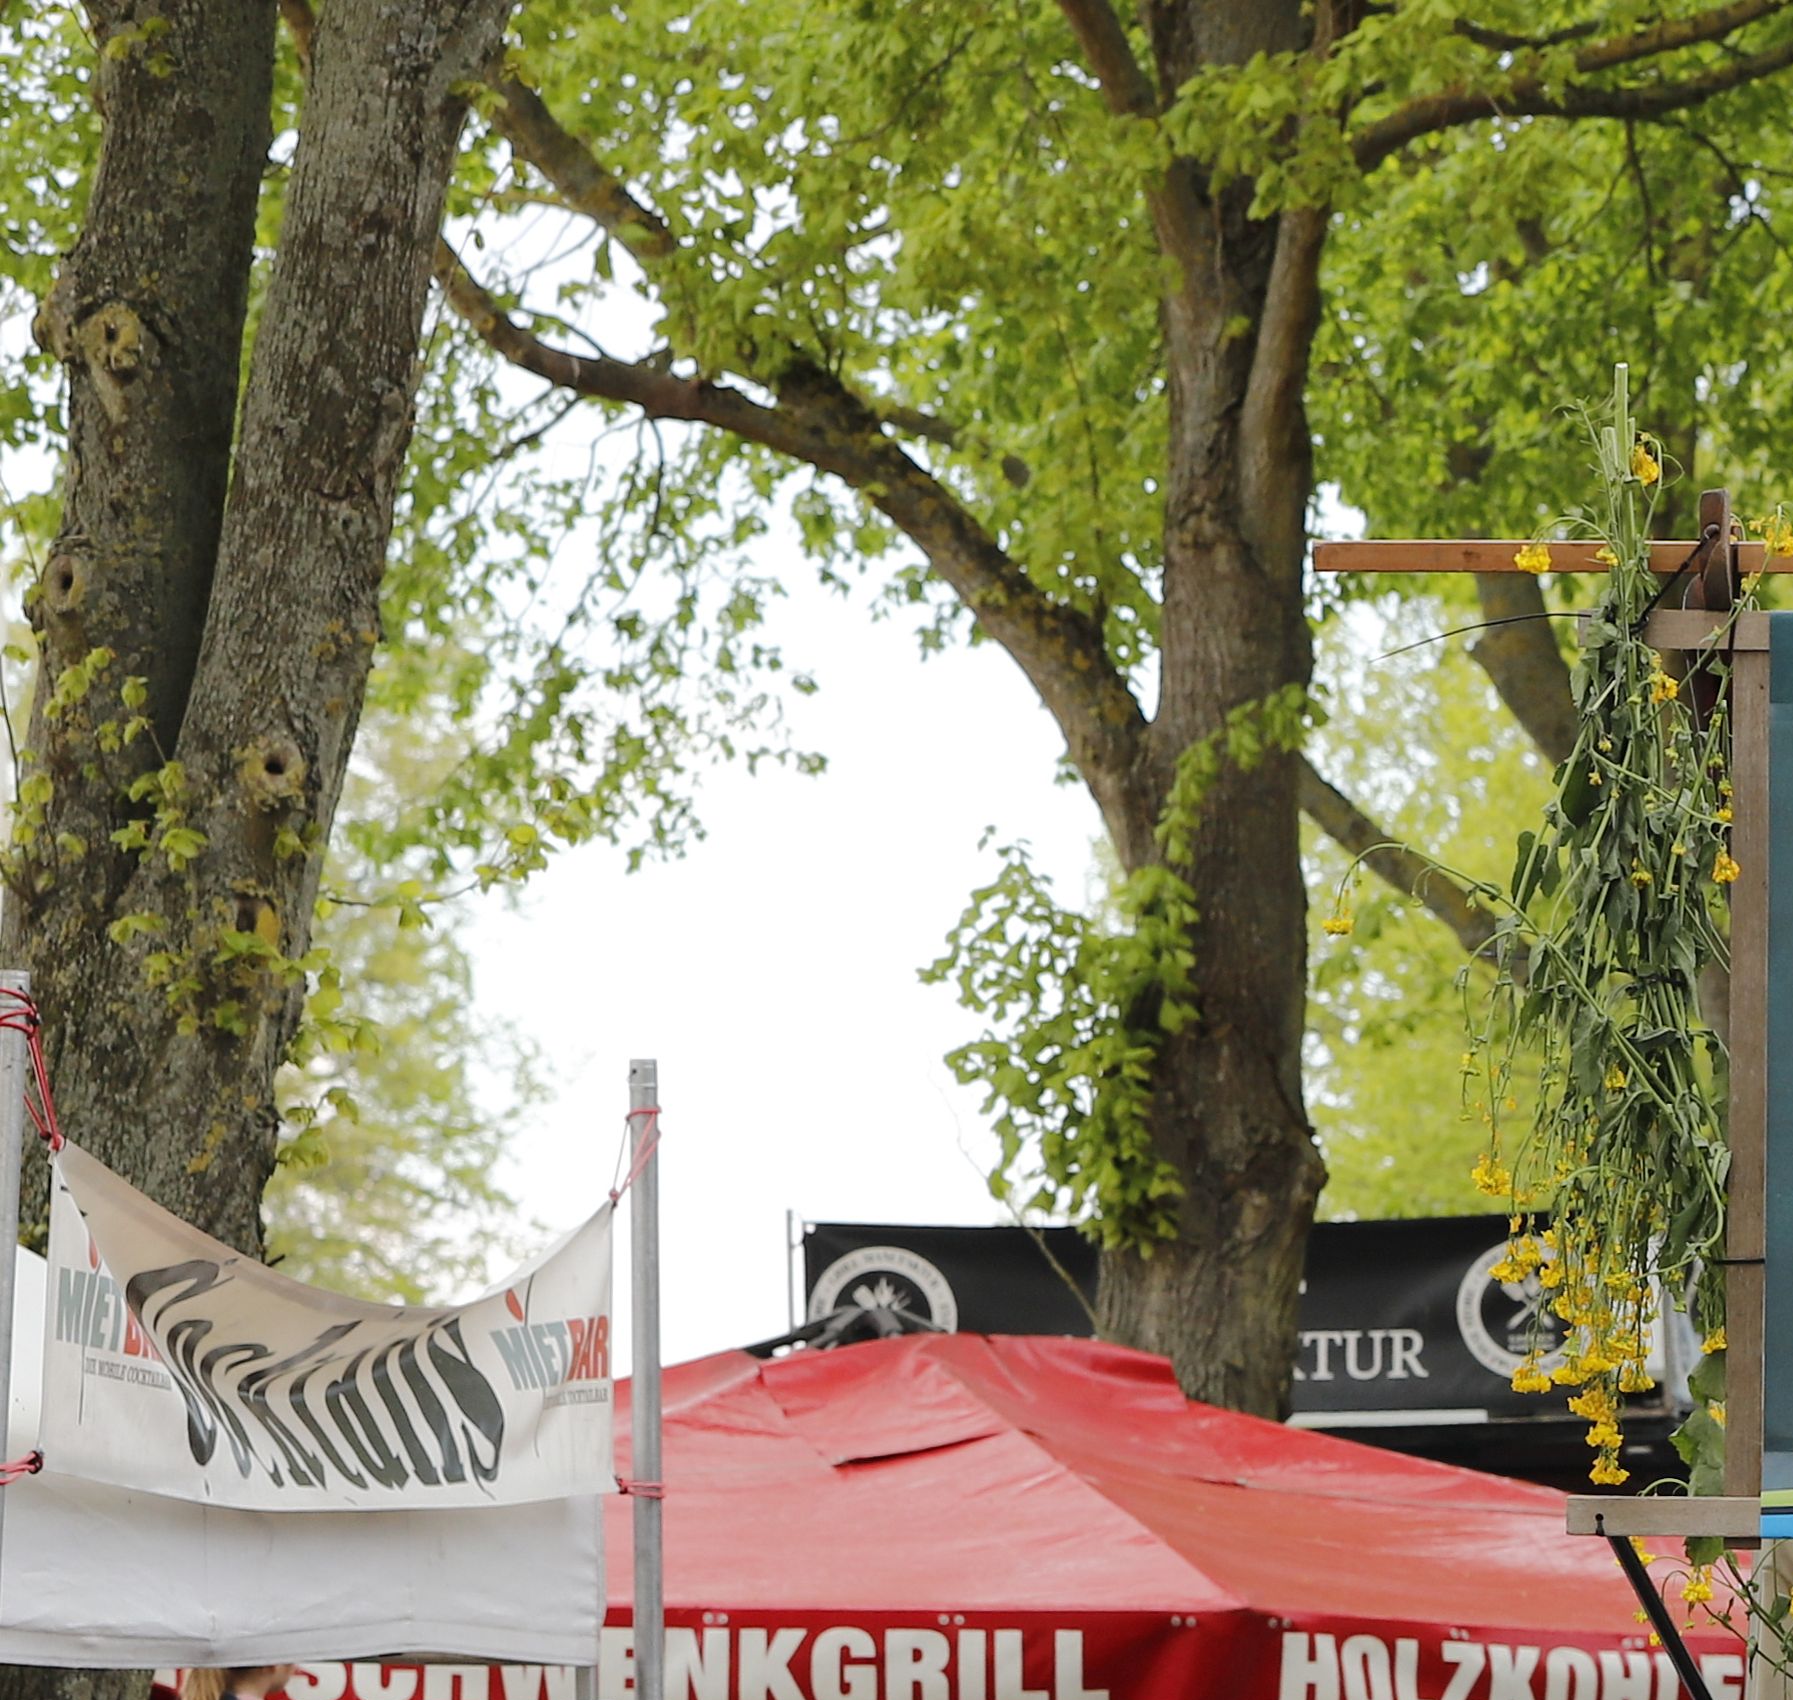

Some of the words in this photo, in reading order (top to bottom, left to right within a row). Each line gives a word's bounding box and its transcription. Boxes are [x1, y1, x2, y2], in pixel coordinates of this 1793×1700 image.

[56, 1266, 163, 1363] MIETB
[489, 1315, 609, 1391] MIETBAR
[1293, 1328, 1430, 1381] TUR
